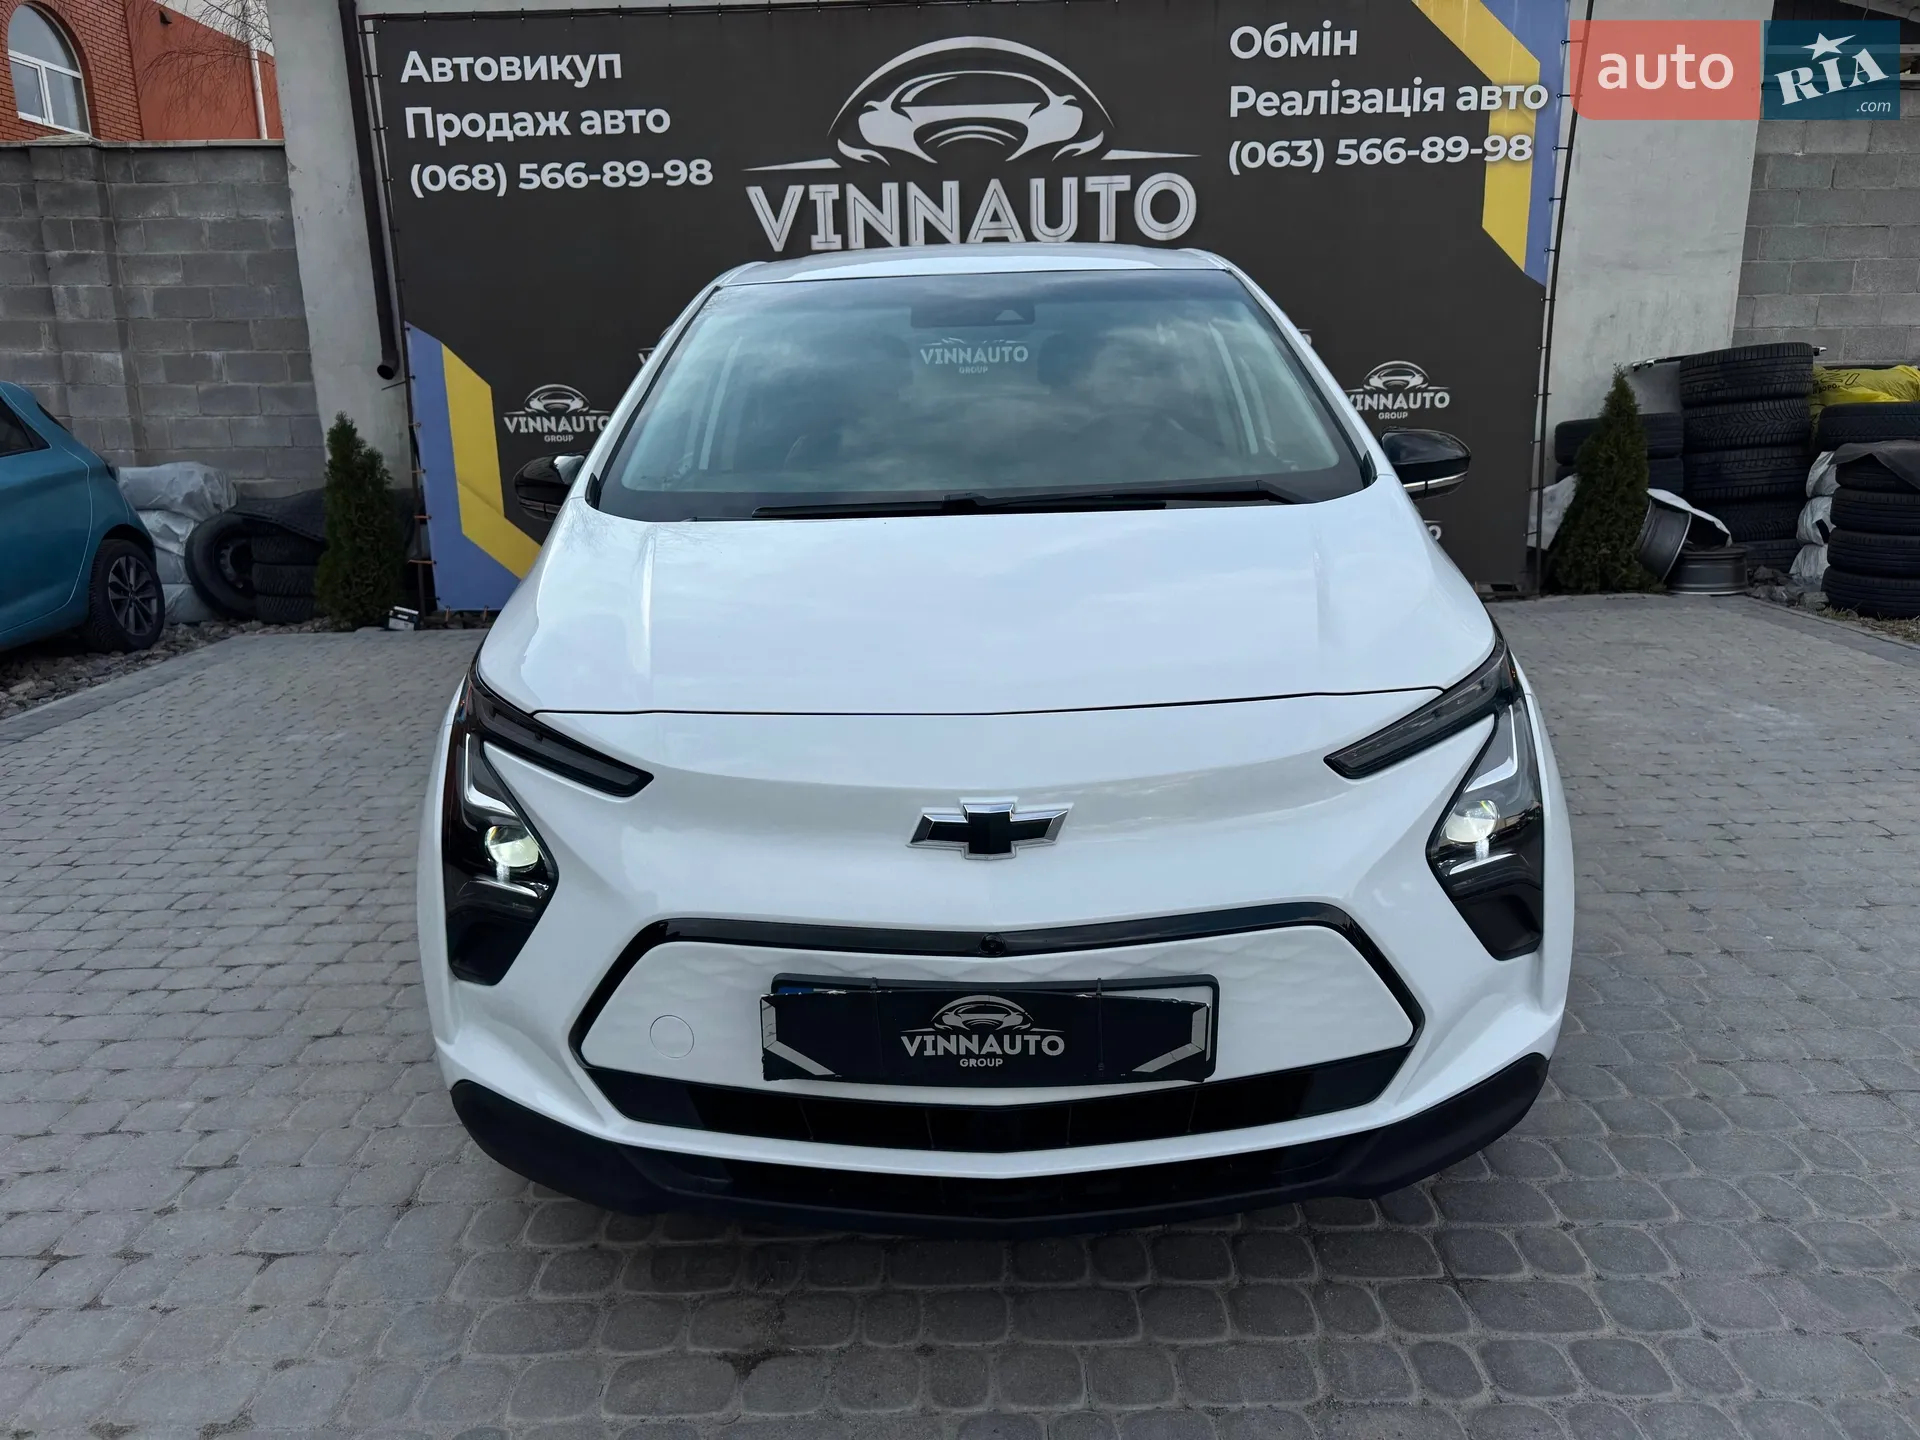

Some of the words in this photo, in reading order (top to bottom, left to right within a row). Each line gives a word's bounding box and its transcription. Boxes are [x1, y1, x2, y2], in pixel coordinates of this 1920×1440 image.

[1229, 20, 1358, 59] Обмін
[400, 51, 623, 88] Автовикуп
[1229, 76, 1445, 118] Реалізація
[1456, 83, 1549, 112] авто
[404, 106, 571, 147] Продаж
[580, 108, 672, 135] авто
[1228, 138, 1325, 176] (063)
[1335, 134, 1533, 166] 566-89-98
[410, 162, 508, 198] (068)
[518, 158, 714, 190] 566-89-98
[745, 172, 1197, 252] VINNAUTO
[920, 345, 1029, 364] VINNAUTO
[959, 365, 988, 375] GROUP
[1378, 411, 1408, 420] GROUP
[544, 434, 574, 443] GROUP
[900, 1034, 1065, 1057] VINNAUTO
[959, 1058, 1004, 1067] GROUP
